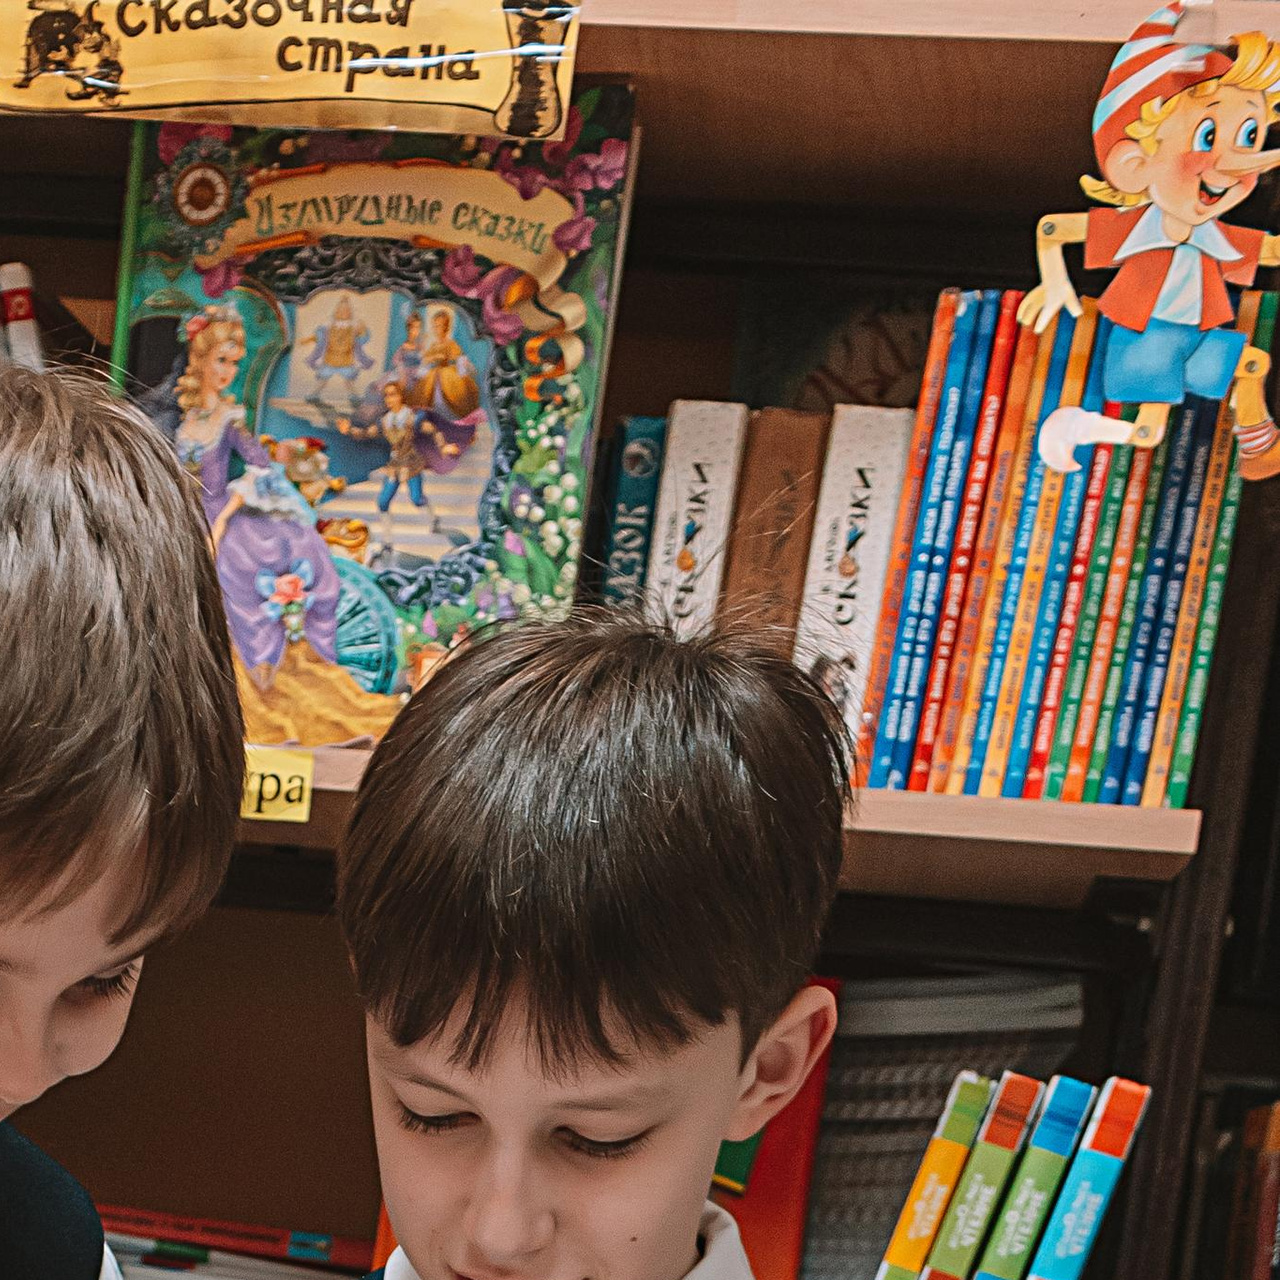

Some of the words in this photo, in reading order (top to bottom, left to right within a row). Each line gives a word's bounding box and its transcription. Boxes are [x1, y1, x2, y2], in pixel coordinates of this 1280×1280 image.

[276, 35, 480, 92] страна
[604, 502, 649, 604] АЗОК
[248, 771, 304, 813] ра
